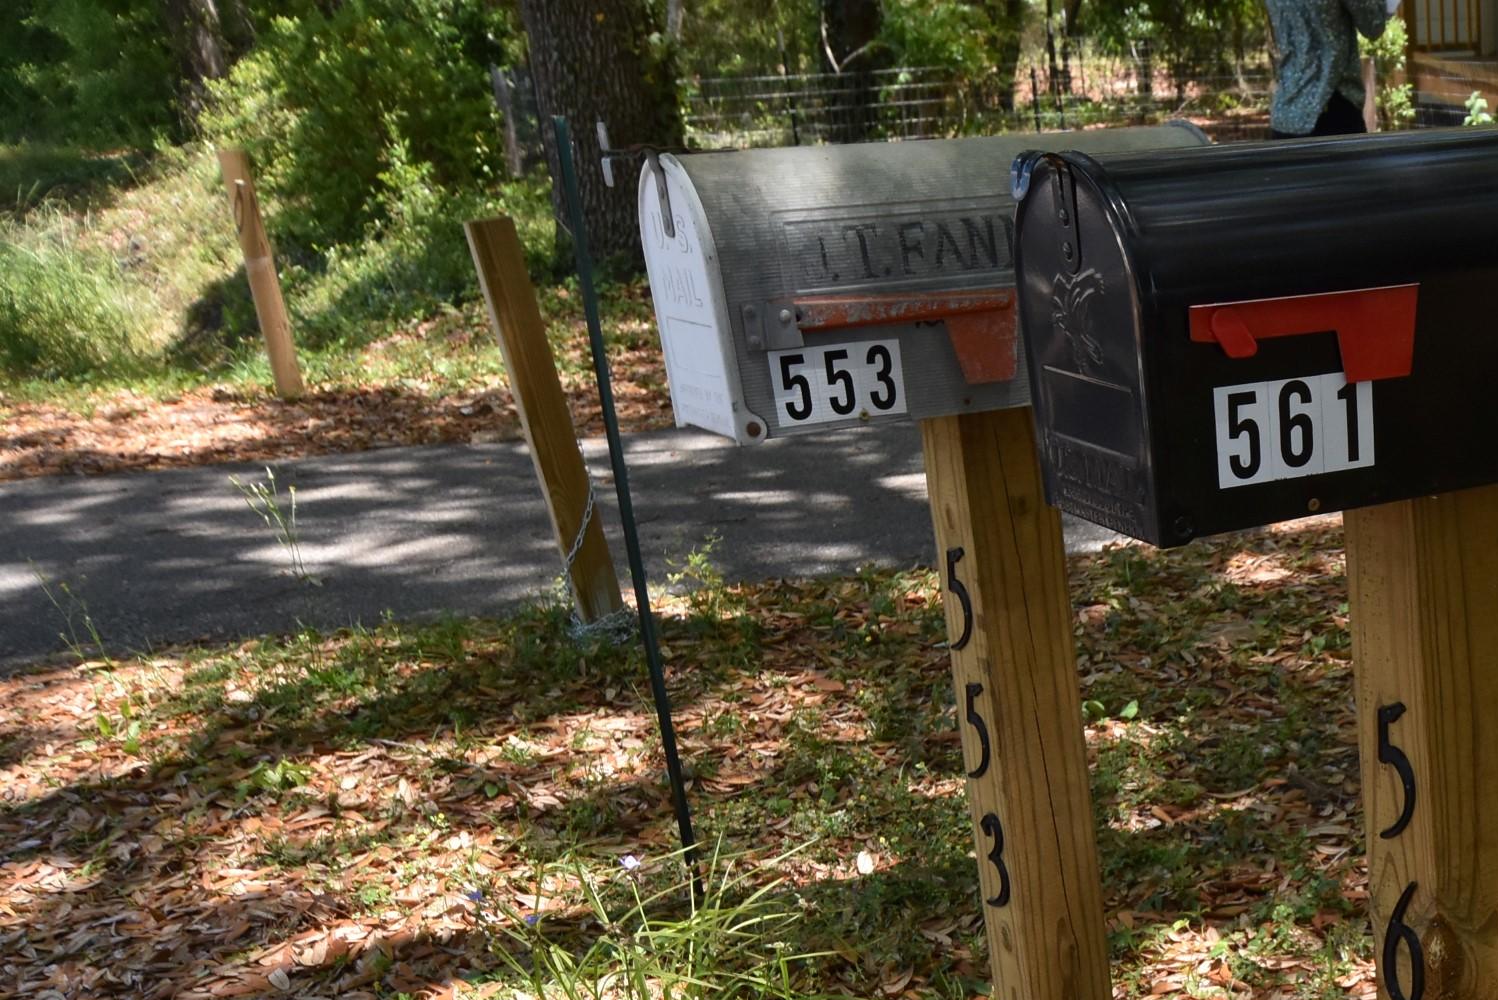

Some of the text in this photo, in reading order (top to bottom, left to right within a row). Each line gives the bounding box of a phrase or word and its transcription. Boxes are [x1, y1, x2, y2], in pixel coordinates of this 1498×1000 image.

[661, 264, 704, 307] MAIL
[779, 344, 897, 421] 553
[1227, 379, 1360, 480] 561
